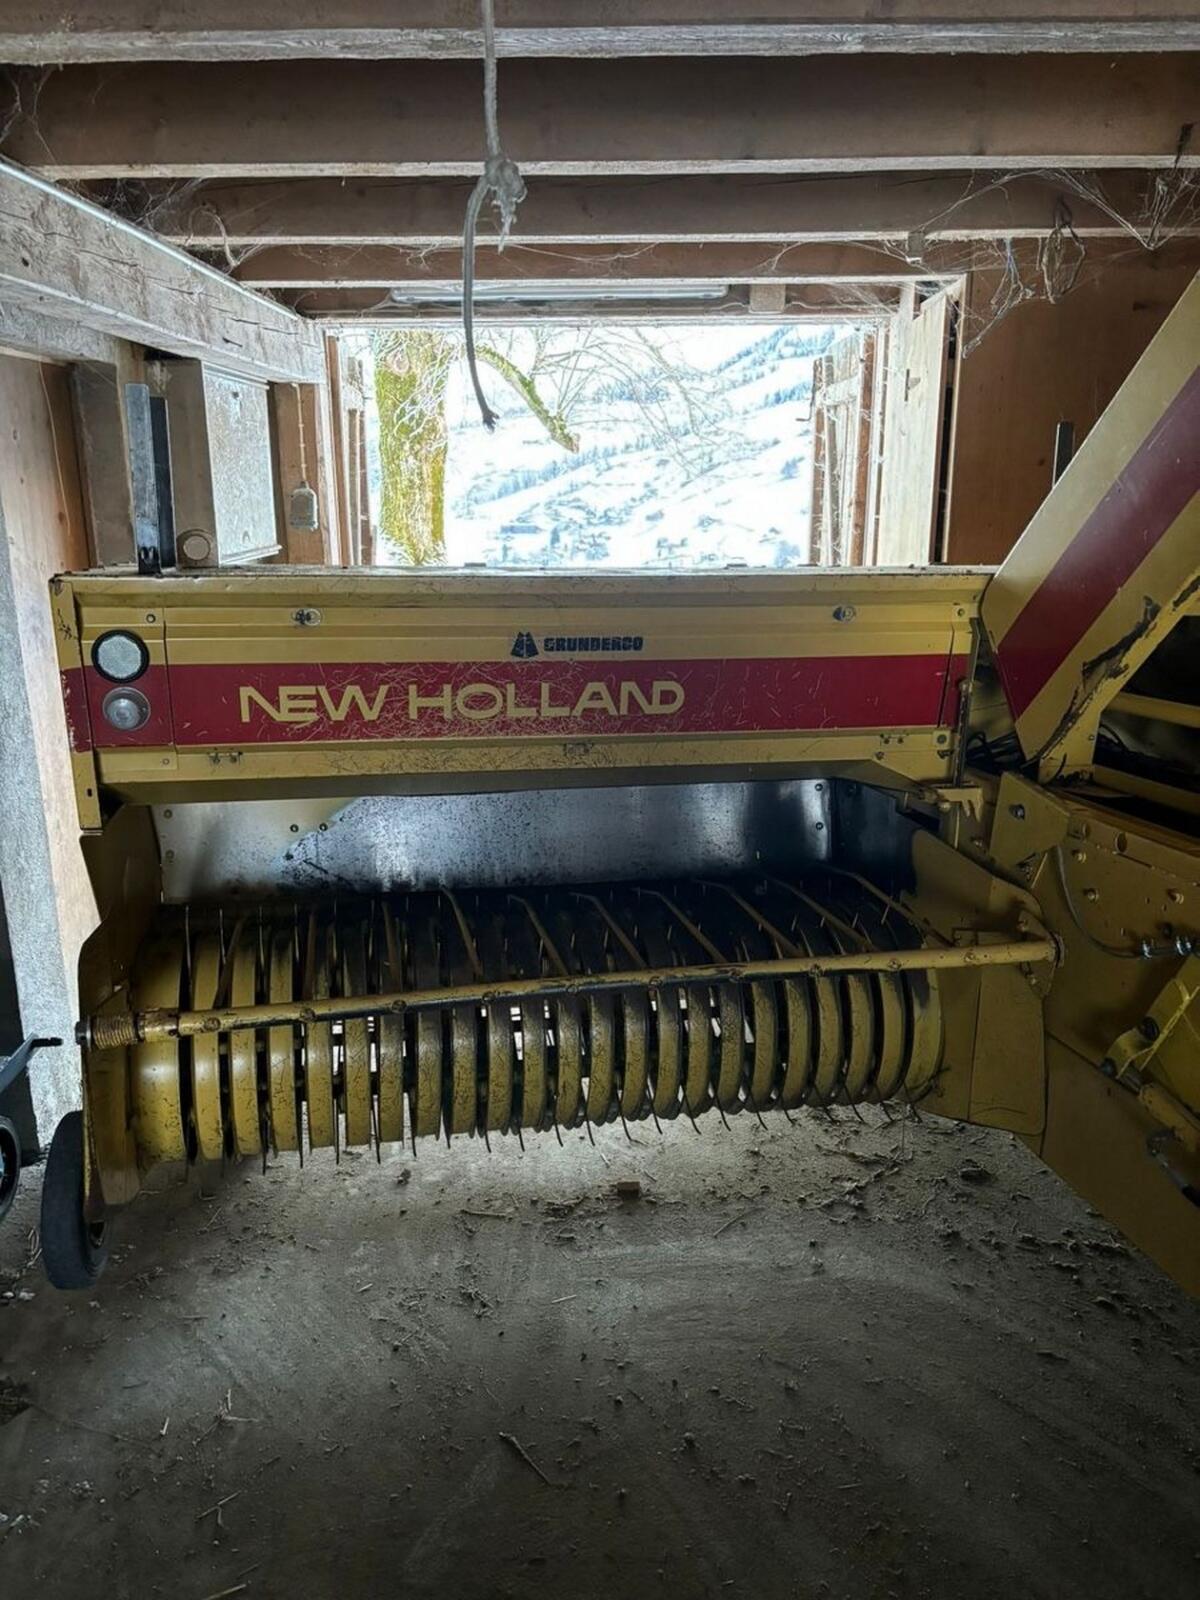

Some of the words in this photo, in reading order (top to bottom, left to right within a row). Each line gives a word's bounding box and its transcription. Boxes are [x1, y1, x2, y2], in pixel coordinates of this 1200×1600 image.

[543, 636, 644, 652] GRUNDERCO
[239, 684, 390, 723] NEW
[408, 680, 685, 720] HOLLAND
